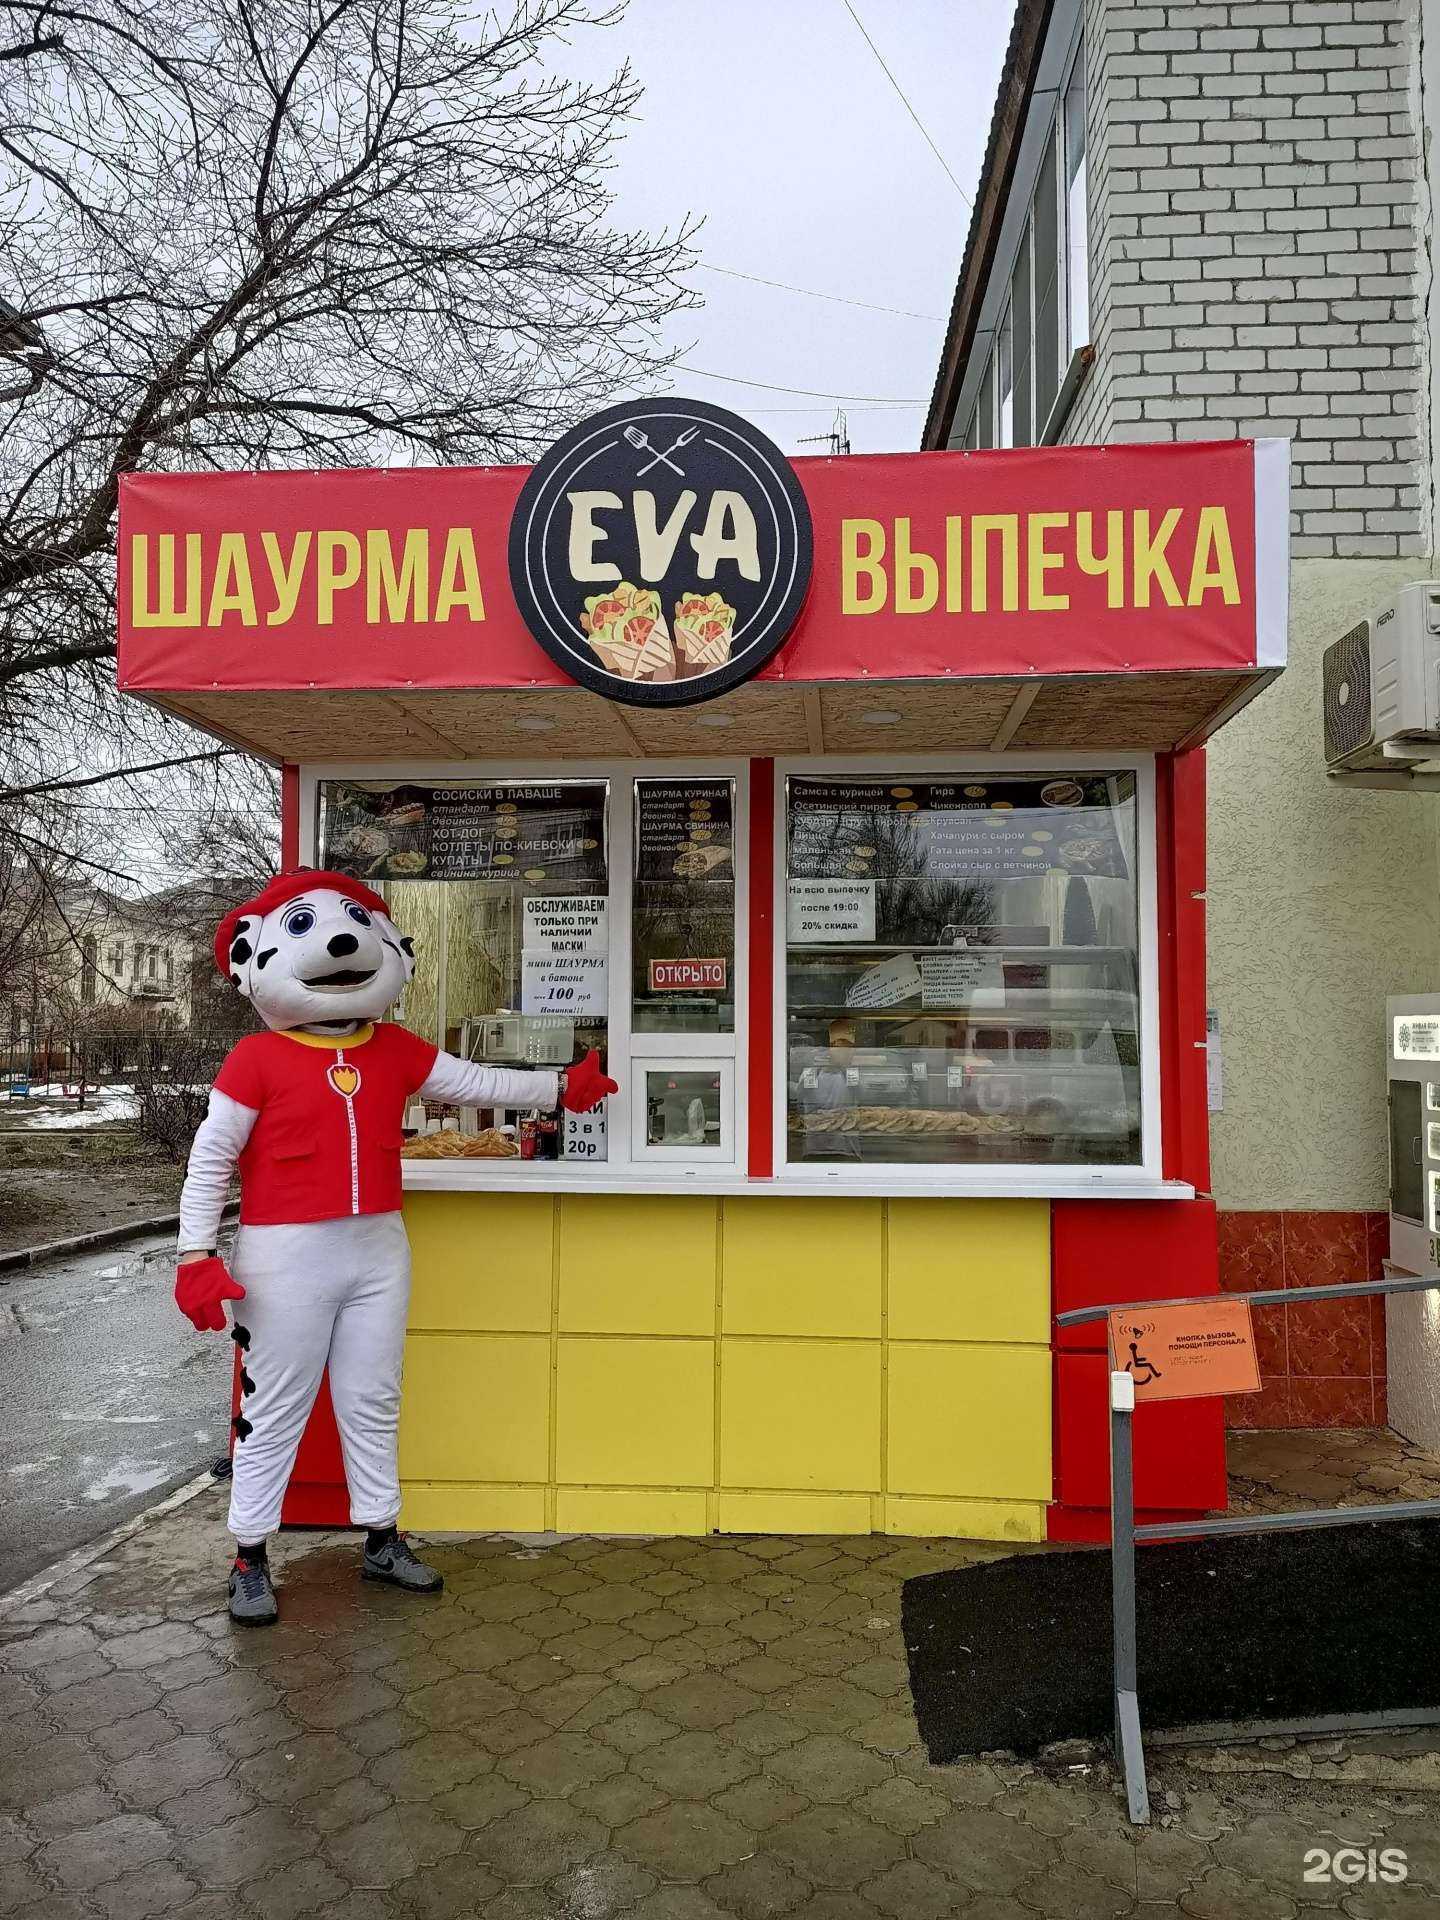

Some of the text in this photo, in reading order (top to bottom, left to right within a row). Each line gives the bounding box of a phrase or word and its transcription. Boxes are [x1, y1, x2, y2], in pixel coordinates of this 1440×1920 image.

[567, 489, 761, 583] EVA
[841, 506, 1241, 616] ВЫПЕЧКА
[131, 527, 486, 629] ШАУРМА
[432, 787, 562, 801] СОСИСКИ В ЛАВАШЕ
[642, 789, 728, 799] ШАУРМА КУРИНАЯ
[793, 786, 829, 796] Самса
[840, 787, 884, 798] курицей
[432, 803, 490, 814] стандарт
[642, 801, 685, 810] стандарт
[860, 803, 893, 811] пирог
[432, 816, 479, 826] двойной
[642, 821, 730, 831] ШАУРМА СВИНИНА
[432, 827, 485, 841] ХОТ-ДОГ
[929, 831, 980, 842] Хачапури
[990, 832, 1025, 841] сыром
[432, 841, 491, 853] КОТЛЕТЫ
[495, 839, 575, 851] ПО-КИЕВСКИ
[955, 848, 980, 856] цена
[432, 854, 483, 867] КУПАТЫ
[482, 868, 520, 879] курица
[789, 886, 871, 896] На всю выпечку
[527, 900, 605, 913] ОБСЛУЖИВАЕМ
[800, 903, 860, 913] после 19:00
[534, 916, 598, 926] ТОЛЬКО ПРИ
[801, 921, 860, 931] 20% скидка
[540, 928, 592, 937] НАЛИЧИИ
[527, 958, 605, 968] мини ШАУРМА
[548, 972, 584, 982] батоне
[655, 965, 722, 983] ОТКРЫТО
[547, 987, 574, 1000] 100
[569, 1121, 606, 1134] 3 в 1
[568, 1141, 597, 1156] 20р
[1177, 1332, 1236, 1342] КНОПКА ВЫЗОВА
[1169, 1338, 1246, 1351] ПОМОЩИ ПЕРСОНАЛА
